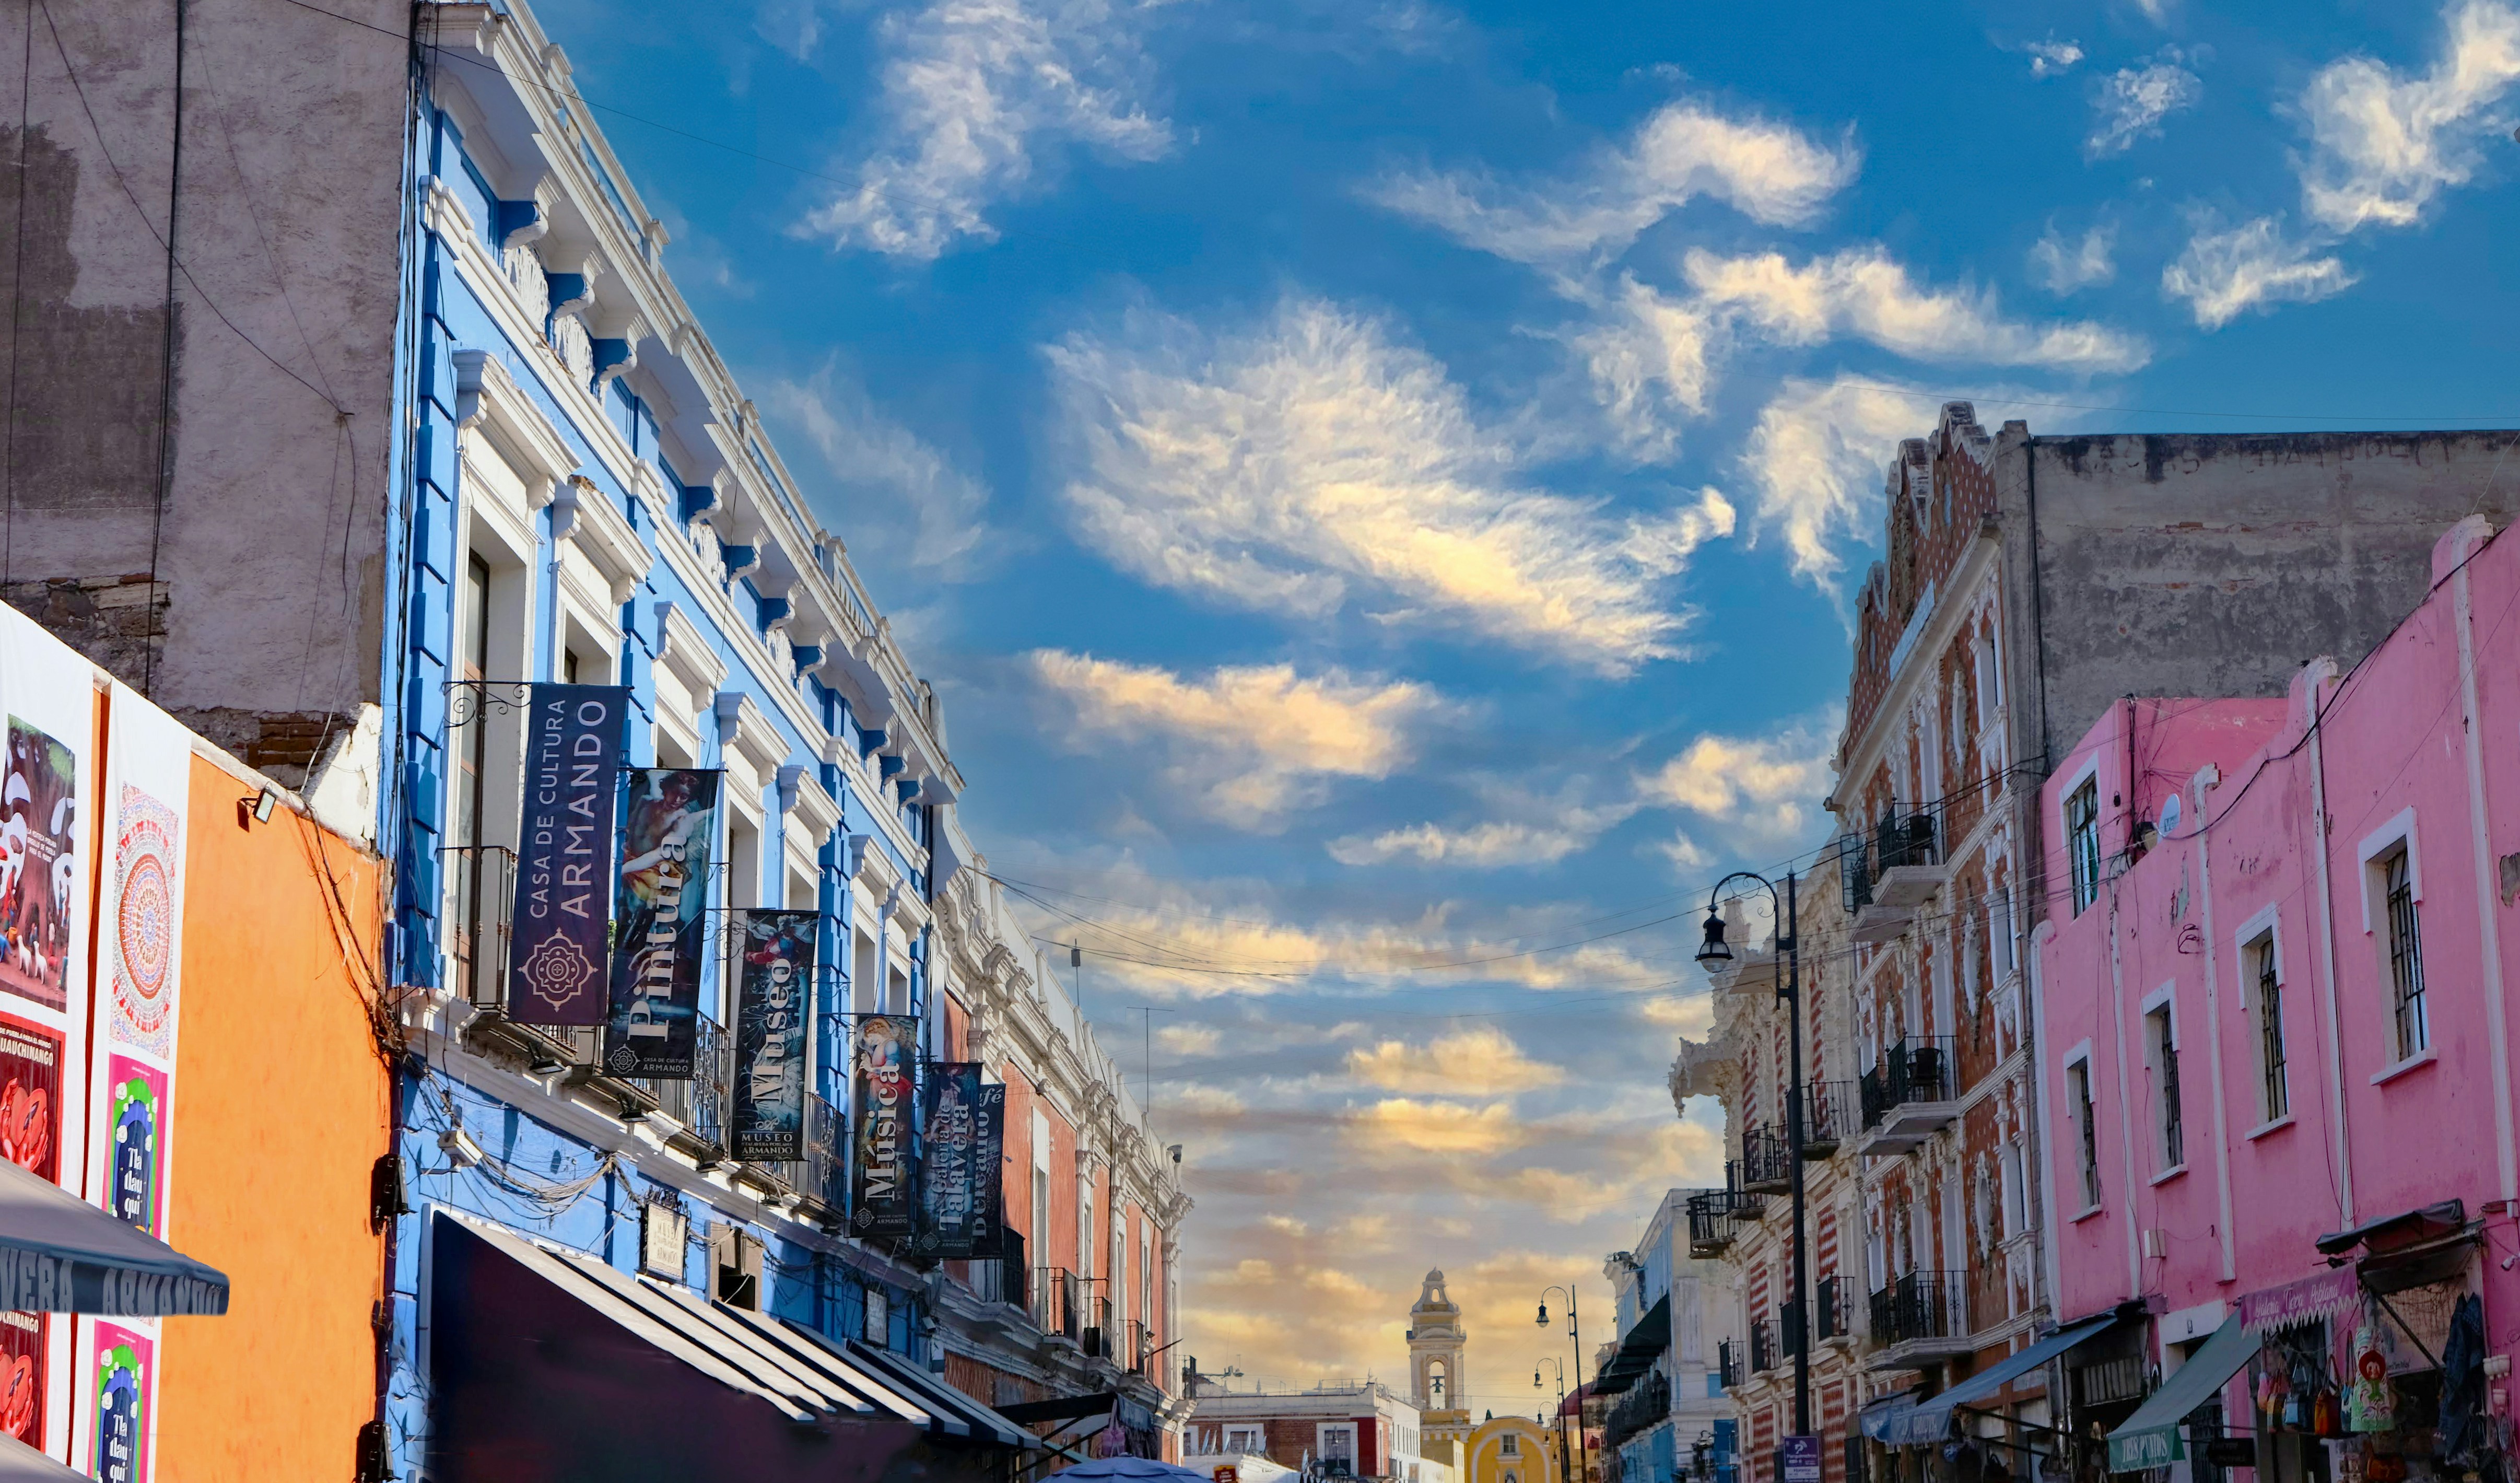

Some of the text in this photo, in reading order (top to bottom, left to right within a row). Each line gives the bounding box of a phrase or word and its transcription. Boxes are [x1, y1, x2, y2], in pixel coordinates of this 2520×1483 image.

[530, 699, 566, 918] CASA DE CULTURA
[561, 700, 606, 919] ARMANDO
[627, 836, 687, 1043] Pintura
[643, 1064, 688, 1072] ARMANDO
[751, 957, 792, 1104] Museo
[742, 1134, 792, 1142] MUSEO
[865, 1063, 901, 1202] Música
[934, 1102, 951, 1124] de
[939, 1103, 969, 1231] Talavera
[0, 1310, 39, 1334] CHINANGO
